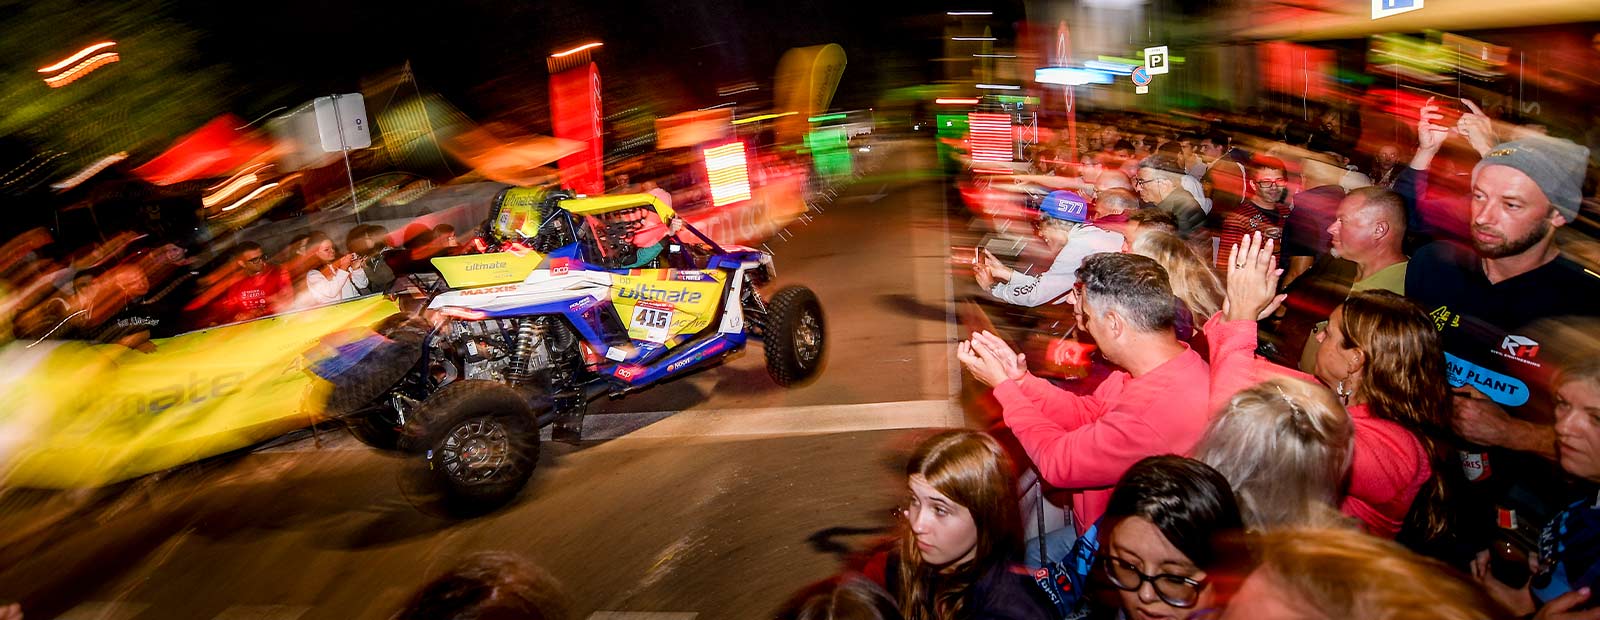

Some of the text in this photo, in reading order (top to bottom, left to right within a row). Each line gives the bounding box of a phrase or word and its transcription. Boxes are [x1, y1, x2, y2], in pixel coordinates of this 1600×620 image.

[1058, 199, 1083, 214] 577
[465, 261, 507, 272] ultimate
[460, 285, 518, 297] MAXXIS
[617, 282, 701, 304] ultimate
[636, 308, 668, 327] 415
[1466, 370, 1519, 395] PLANT
